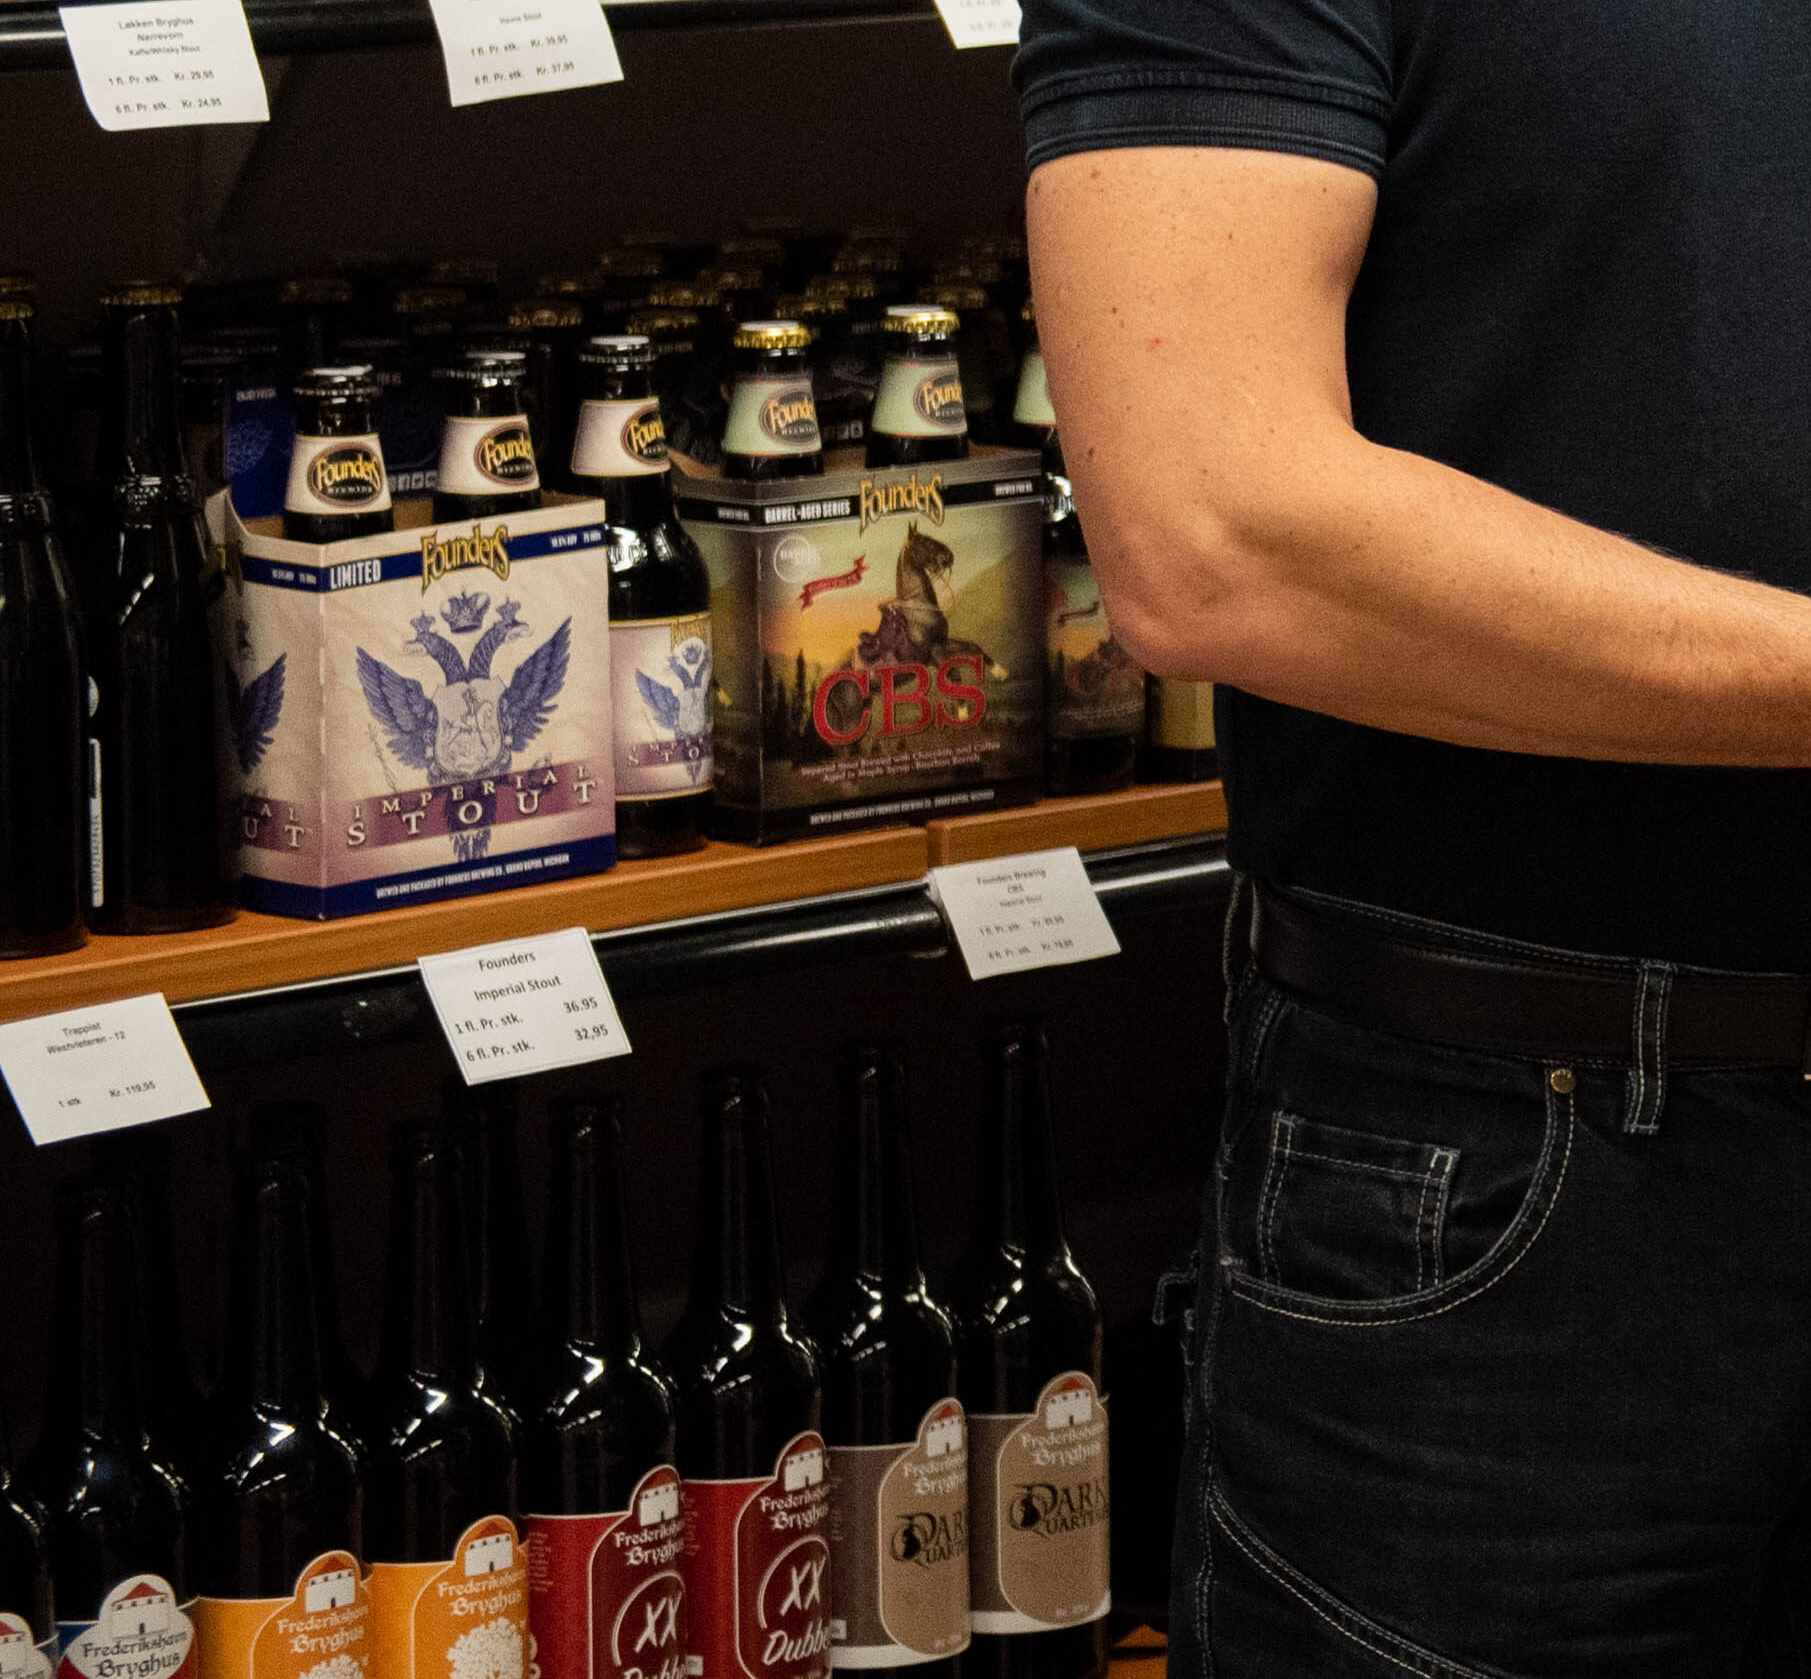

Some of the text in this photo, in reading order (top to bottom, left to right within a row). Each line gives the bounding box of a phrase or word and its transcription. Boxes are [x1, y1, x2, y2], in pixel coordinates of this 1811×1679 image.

[859, 474, 946, 539] Founders
[330, 558, 382, 590] LIMITED
[420, 523, 511, 597] Founders
[812, 653, 988, 748] CBS
[354, 766, 587, 819] IMPERIAL
[347, 780, 596, 847] STOUT
[478, 951, 537, 972] Founders
[474, 975, 562, 1002] Imperial Stout
[61, 1022, 102, 1037] Trappist
[114, 1031, 126, 1041] 12
[454, 1022, 464, 1035] 1
[464, 1020, 479, 1033] fl.
[481, 1018, 499, 1031] Pr.
[500, 1012, 524, 1027] stk.
[466, 1023, 609, 1062] 6 fl. Pr. stk. 32,95
[780, 1555, 827, 1617] XX
[635, 1590, 683, 1654] XX
[96, 1652, 182, 1679] Bryghus
